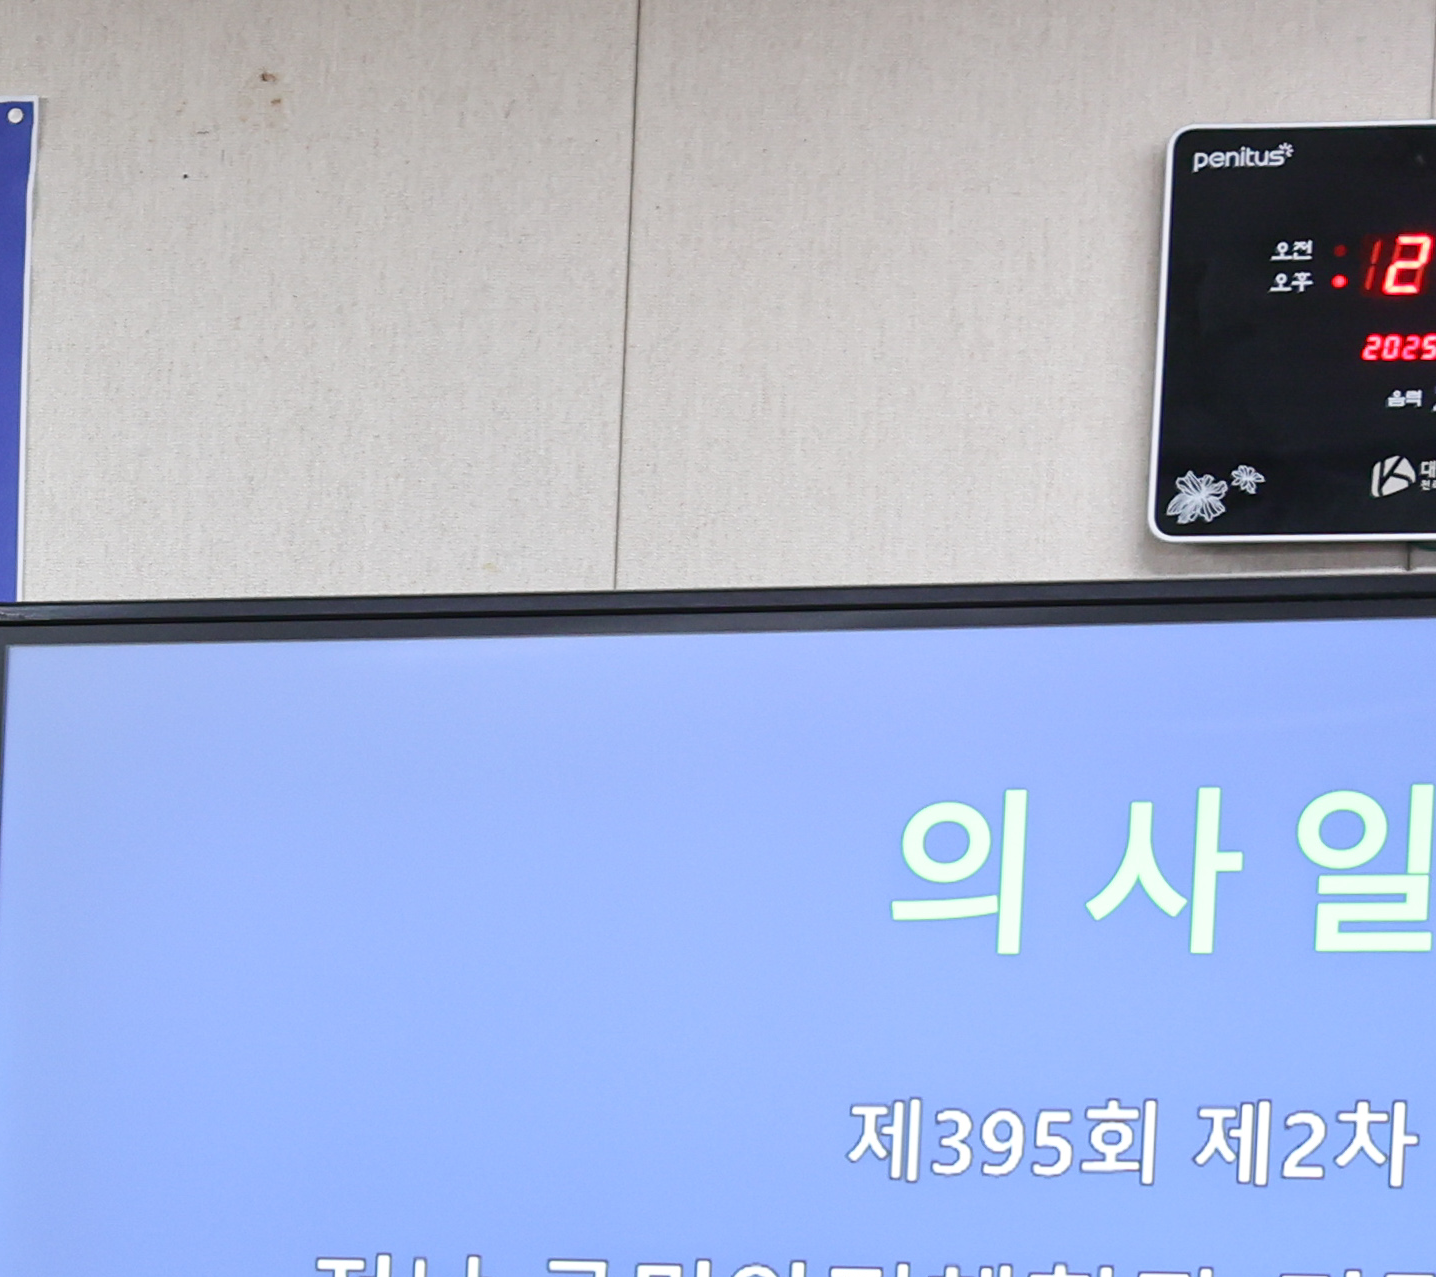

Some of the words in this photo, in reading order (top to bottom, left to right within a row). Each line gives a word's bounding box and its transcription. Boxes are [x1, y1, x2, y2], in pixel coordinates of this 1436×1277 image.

[1194, 147, 1284, 172] penitus
[1270, 239, 1313, 261] 오전
[1269, 272, 1314, 293] 오후
[847, 1098, 1158, 1186] 제395회
[1194, 1100, 1419, 1188] 제2차
